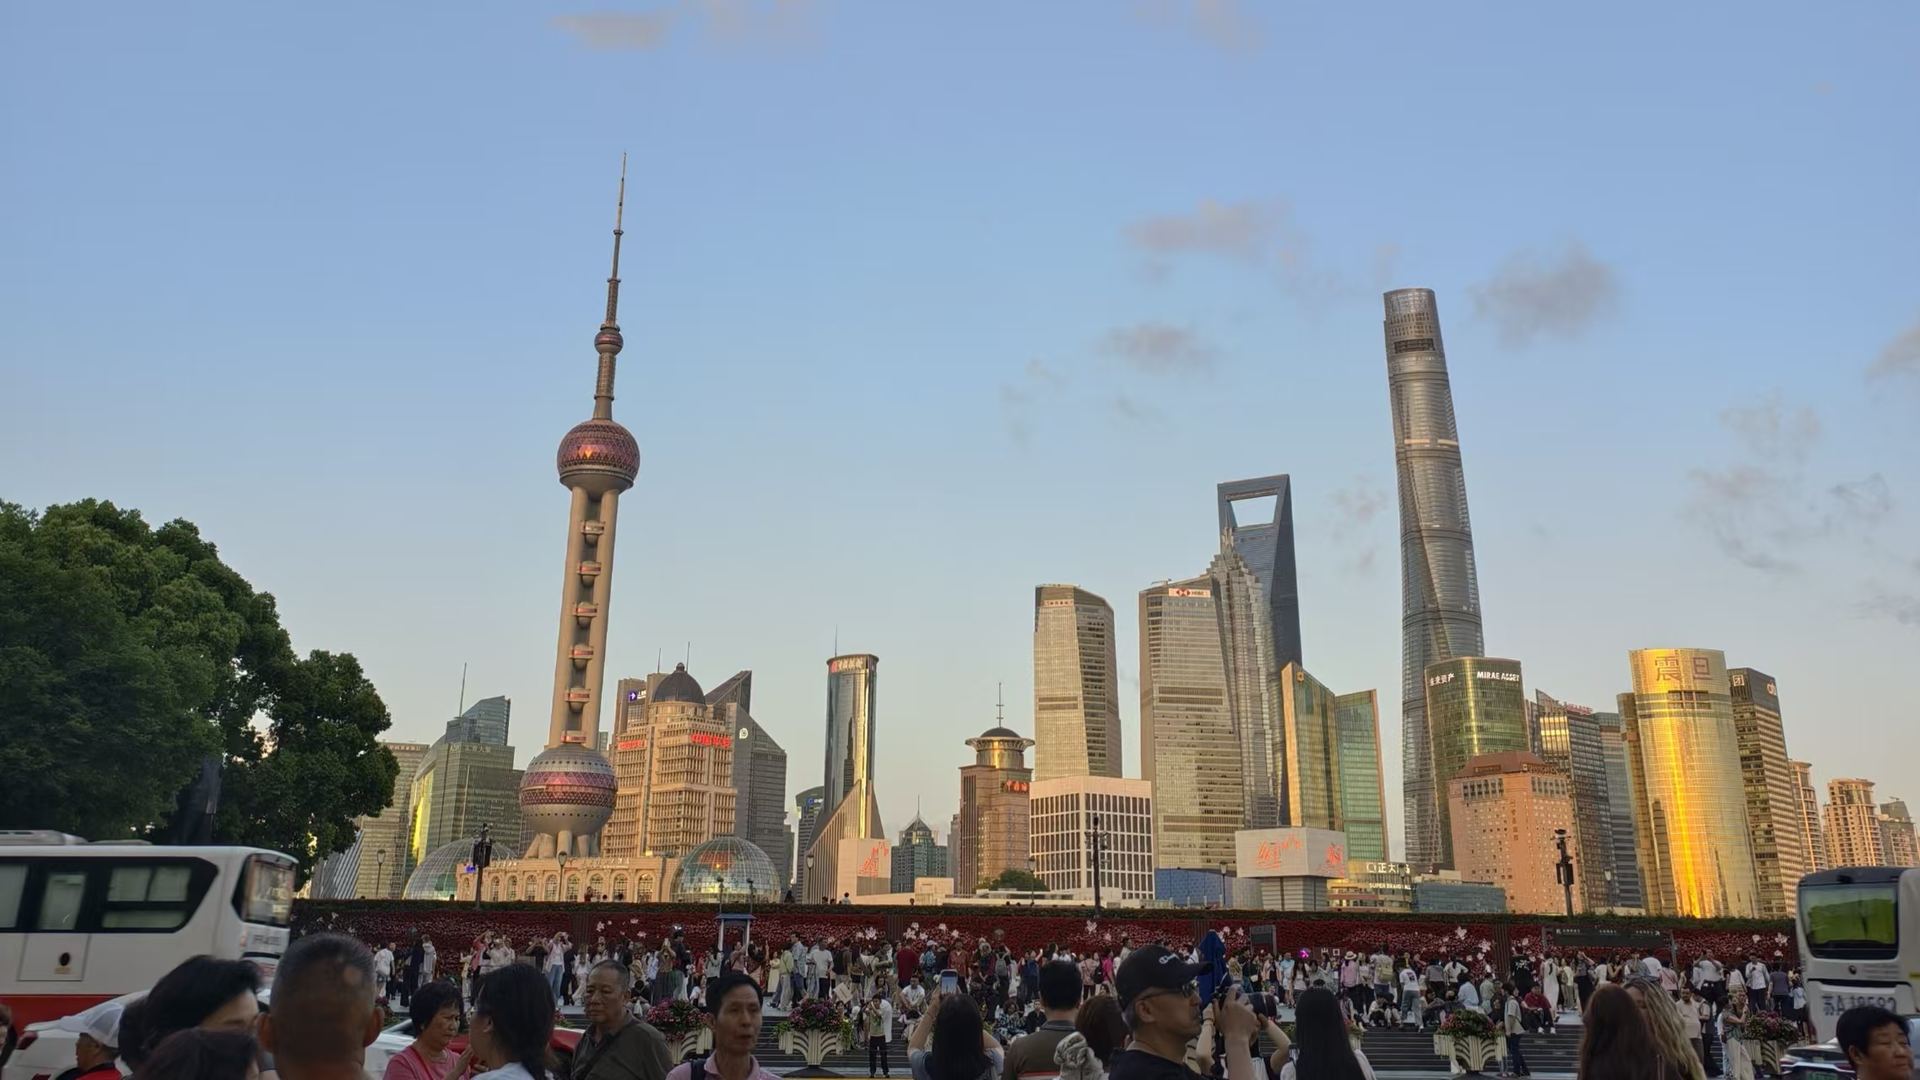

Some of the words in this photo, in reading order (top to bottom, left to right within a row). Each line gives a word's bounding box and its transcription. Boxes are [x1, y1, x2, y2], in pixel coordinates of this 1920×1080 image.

[1655, 656, 1712, 681] 震旦
[1476, 671, 1500, 680] MIRAE
[1501, 672, 1520, 682] ASSET
[1377, 862, 1411, 875] 正大场
